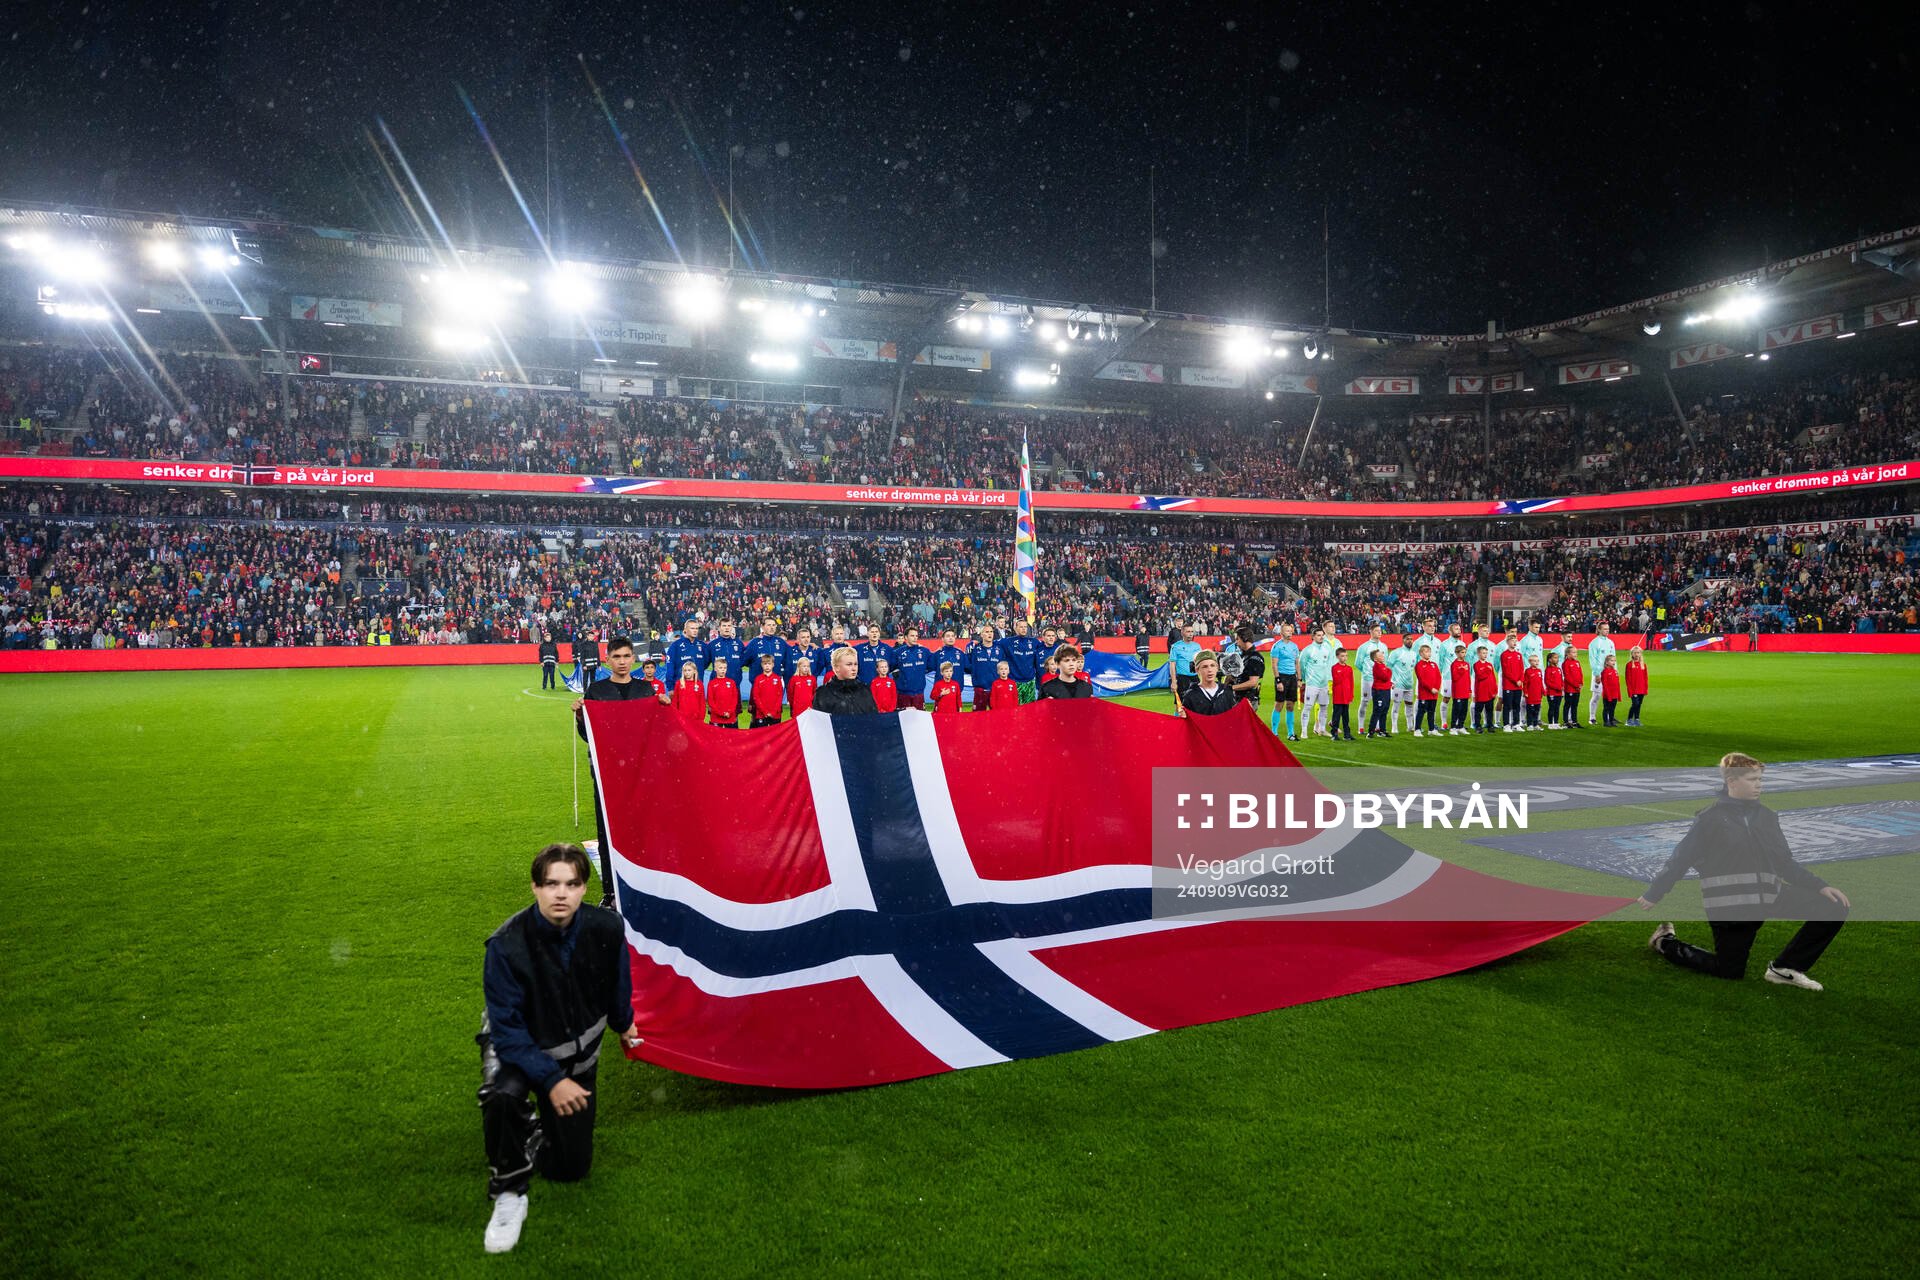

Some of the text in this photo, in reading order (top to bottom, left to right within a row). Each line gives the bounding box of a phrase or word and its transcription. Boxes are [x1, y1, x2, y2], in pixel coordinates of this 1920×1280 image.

[628, 328, 668, 344] Tipping
[1769, 318, 1832, 345] VG
[1680, 343, 1733, 364] VG
[1571, 361, 1629, 380] VG
[1354, 378, 1409, 394] VG
[1461, 374, 1514, 393] VG
[143, 466, 204, 479] senker
[287, 467, 307, 484] på
[312, 468, 337, 482] vår
[341, 469, 374, 485] jord
[1731, 465, 1907, 495] senker drømme på vår jord
[846, 488, 1006, 505] senker drømme på vår jord
[1339, 544, 1363, 552] VG
[1371, 544, 1398, 552] VG
[1406, 544, 1436, 553] VG
[1562, 539, 1590, 548] VG
[1599, 537, 1629, 547] VG
